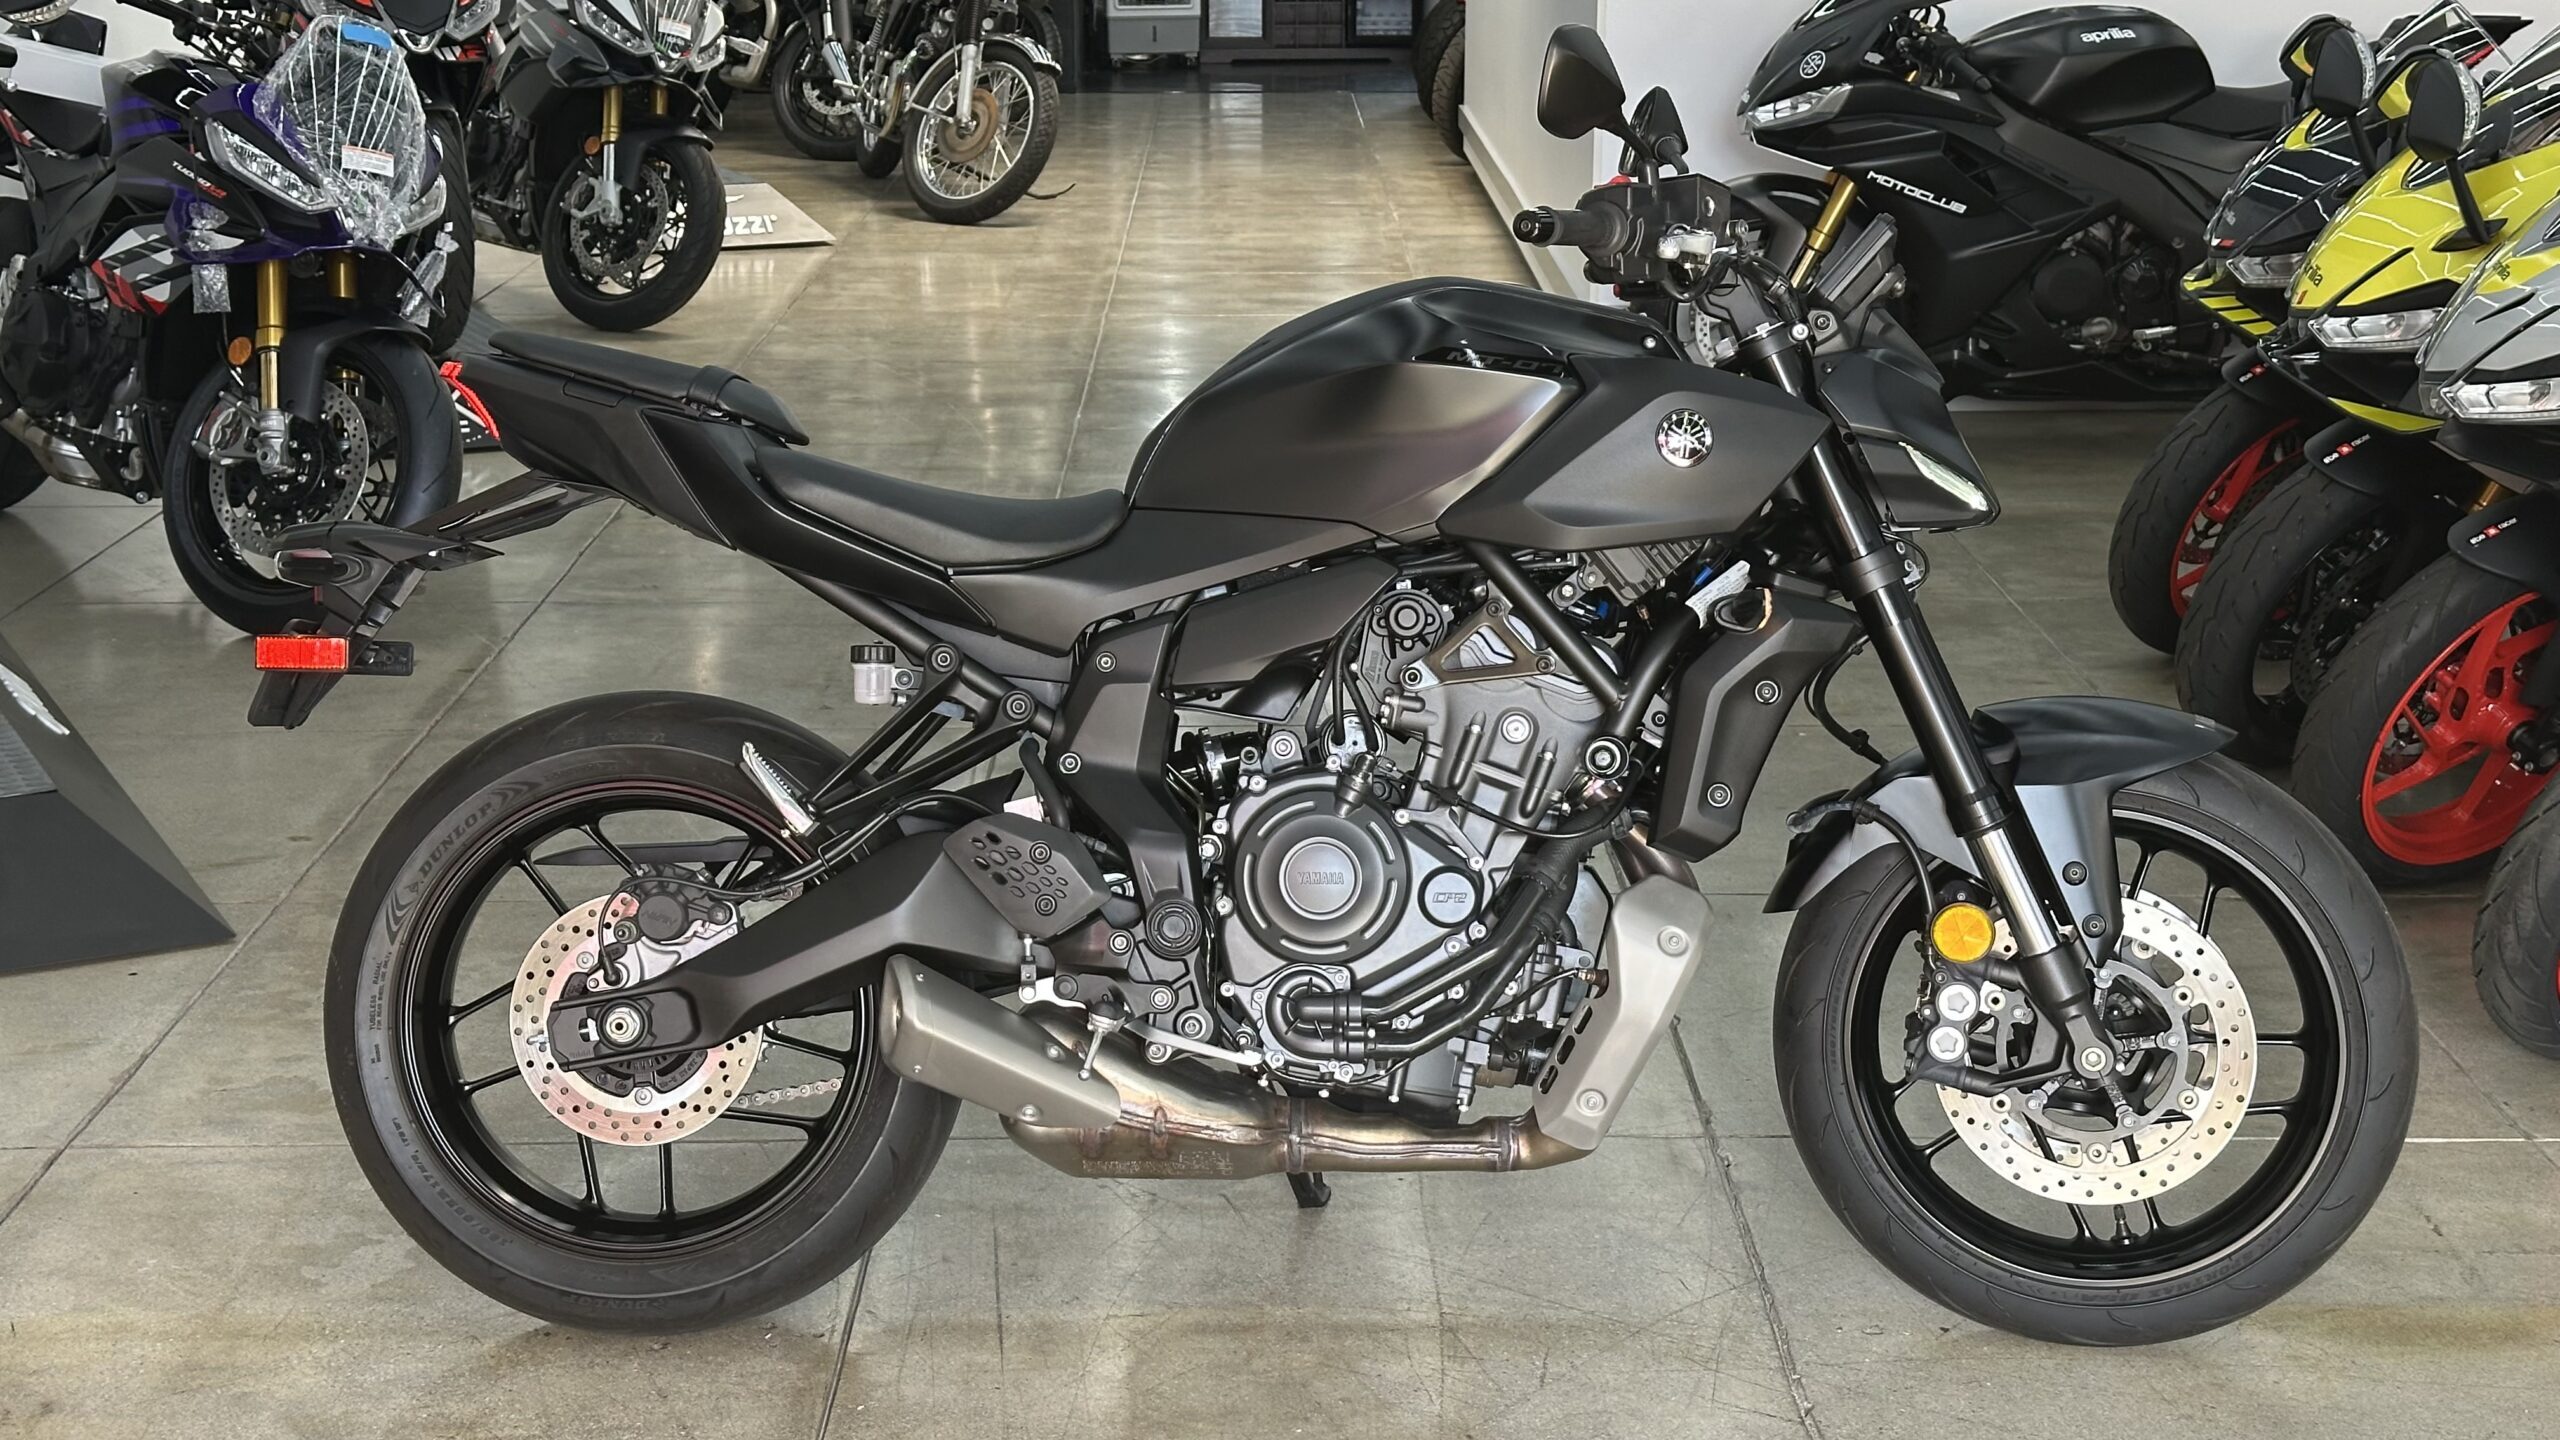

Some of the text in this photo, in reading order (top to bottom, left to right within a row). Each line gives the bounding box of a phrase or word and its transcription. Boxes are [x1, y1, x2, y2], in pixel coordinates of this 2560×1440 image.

[2080, 27, 2136, 43] aprilia
[1446, 350, 1563, 374] MT-07
[418, 801, 494, 877] DUNLOP
[1296, 871, 1344, 885] YAMAHA
